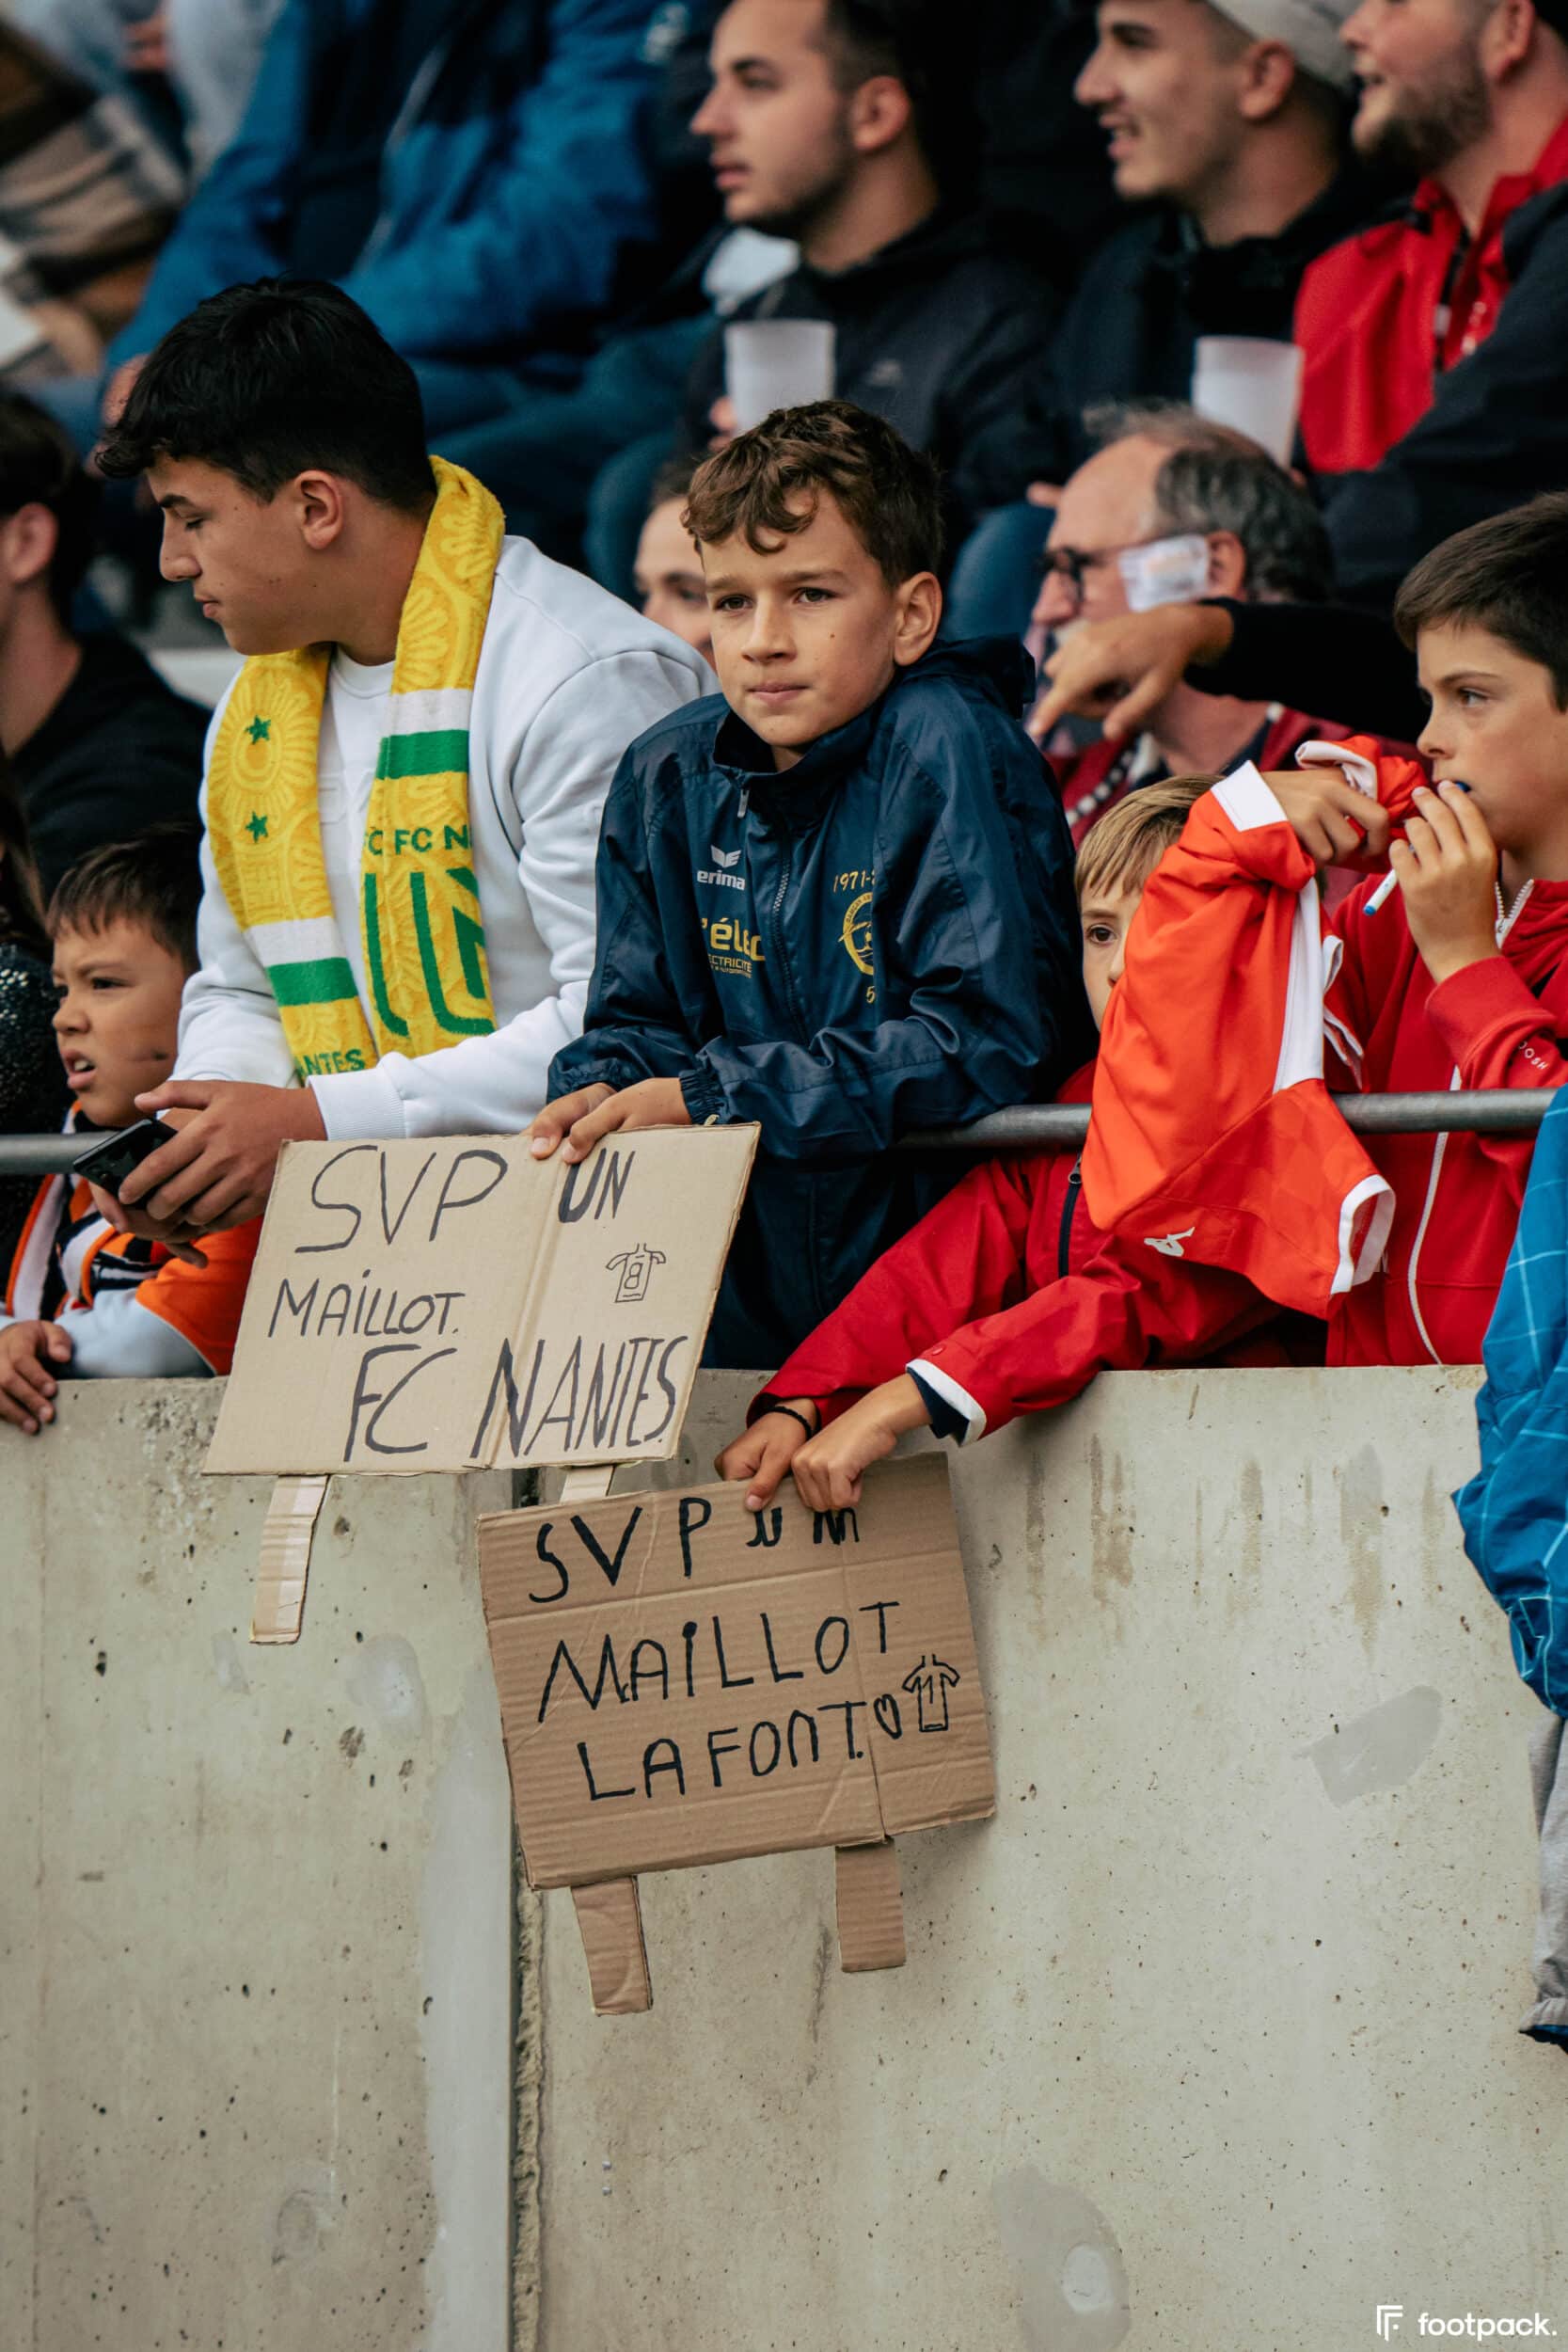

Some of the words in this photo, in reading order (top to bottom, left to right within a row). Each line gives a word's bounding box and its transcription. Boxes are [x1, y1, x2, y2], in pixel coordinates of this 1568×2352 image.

[394, 827, 433, 855] FC
[697, 869, 746, 891] erima
[294, 1144, 509, 1253] SVP
[557, 1147, 636, 1224] UN
[342, 1343, 458, 1463] FC
[528, 1496, 713, 1603] SVP
